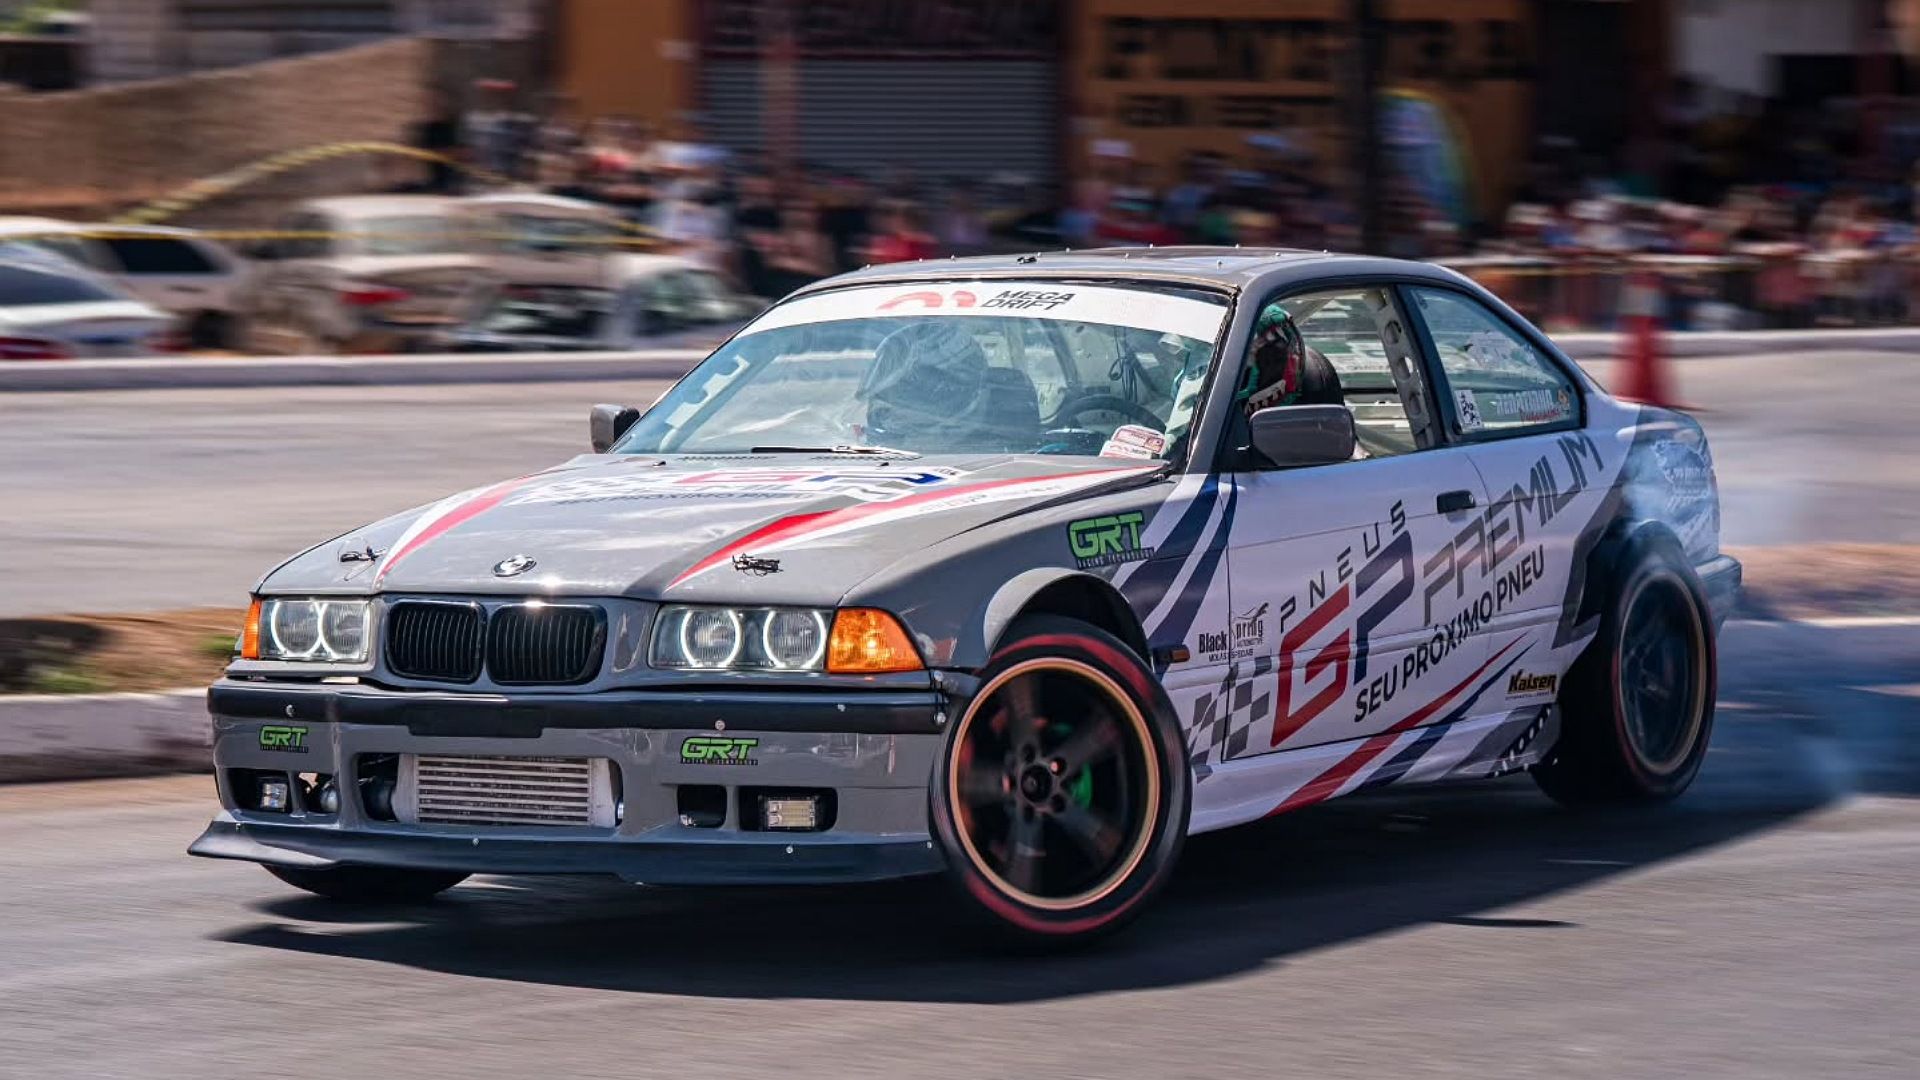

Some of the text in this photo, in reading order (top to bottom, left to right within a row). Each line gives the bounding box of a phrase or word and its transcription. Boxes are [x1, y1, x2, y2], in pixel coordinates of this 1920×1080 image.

[980, 299, 1066, 310] DRIFT
[995, 290, 1076, 302] MEGA
[1068, 511, 1143, 558] GRT
[1280, 499, 1406, 634] PNEUS
[1270, 430, 1604, 747] GP PREMIUM
[1199, 630, 1227, 654] Black
[1354, 545, 1545, 723] SEU PRÓXIMO PNEU
[260, 725, 308, 746] GRT
[681, 737, 758, 760] GRT
